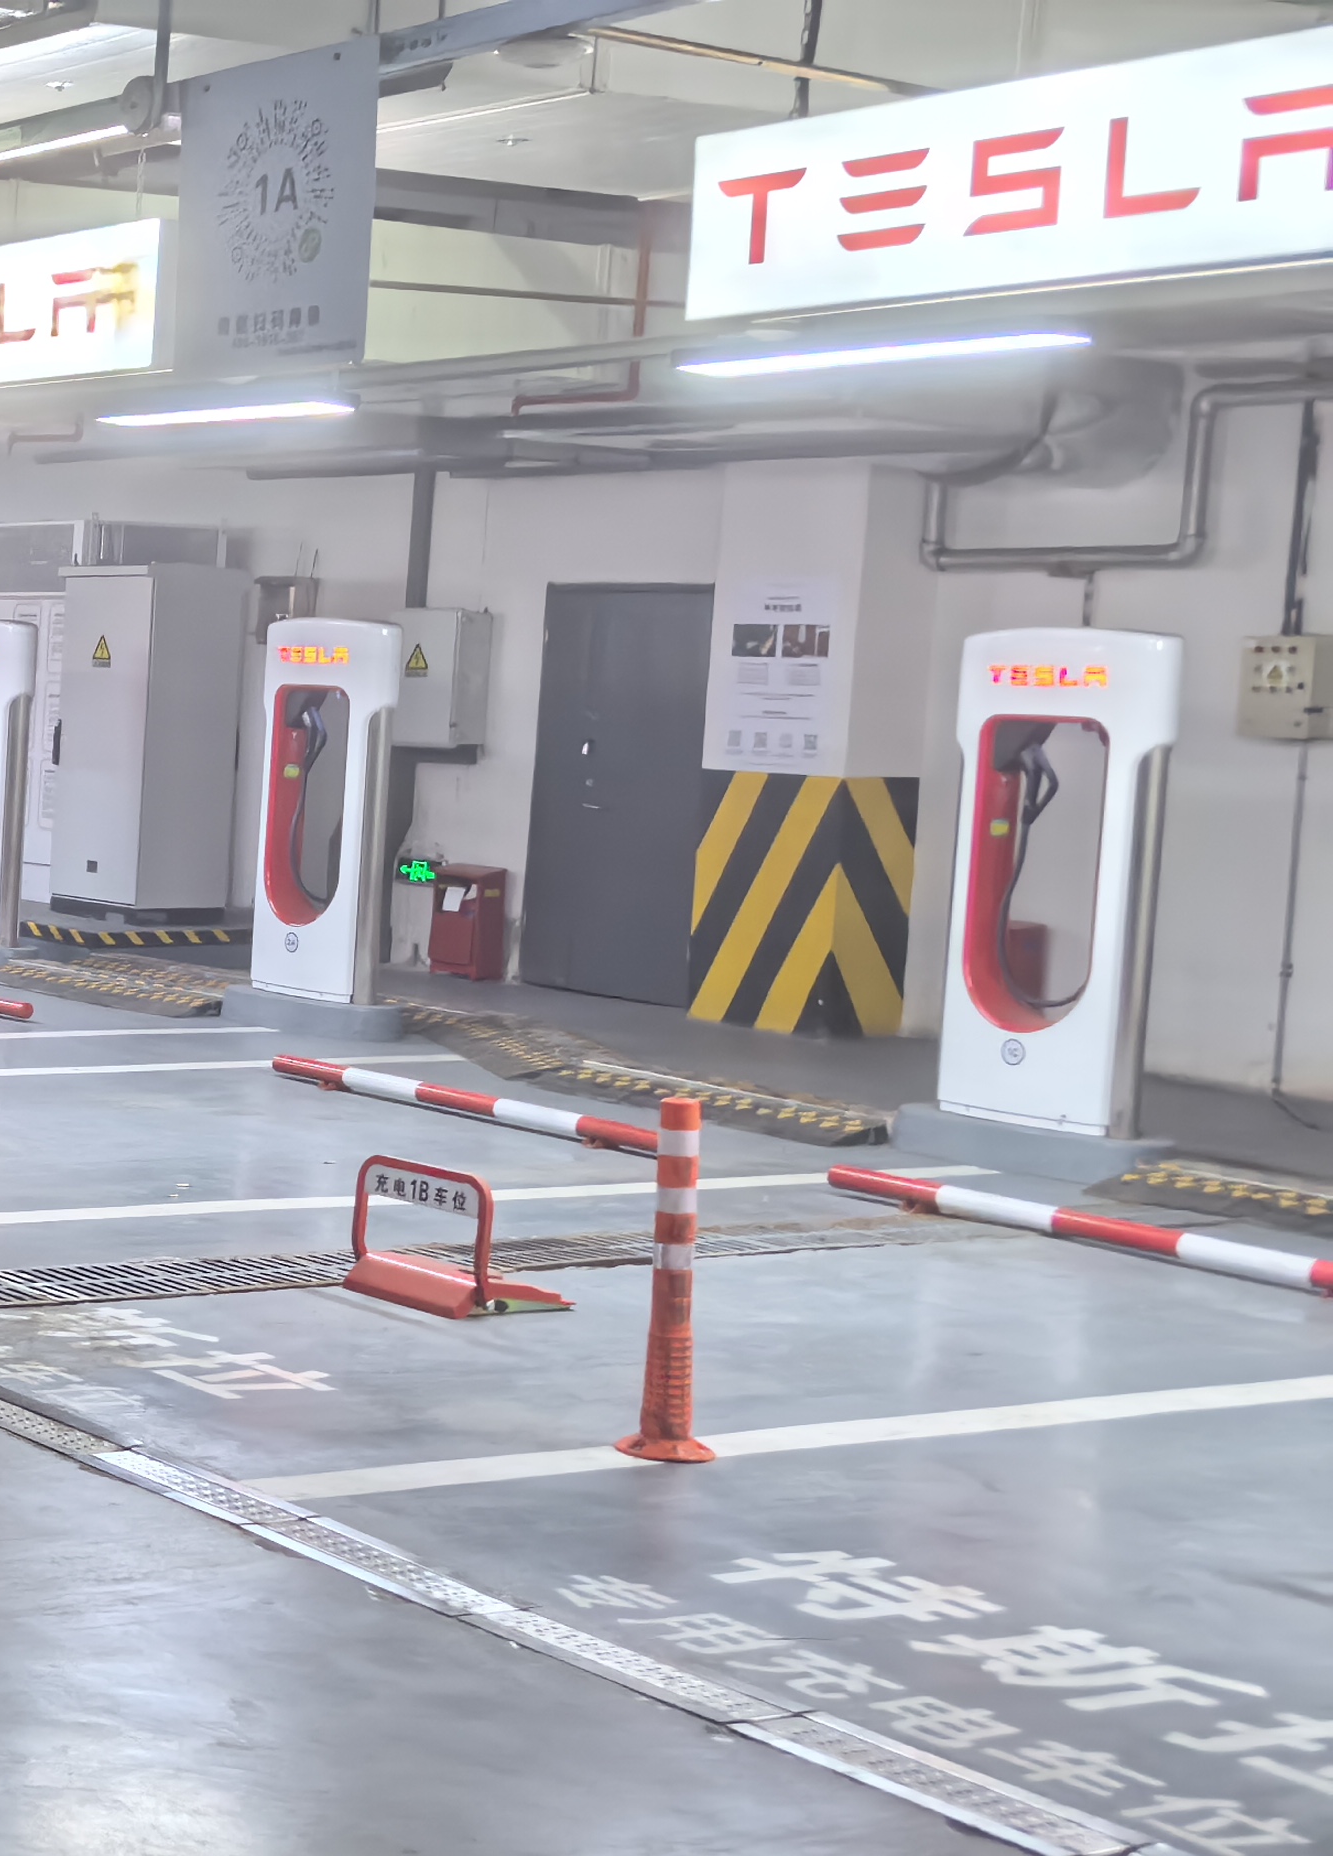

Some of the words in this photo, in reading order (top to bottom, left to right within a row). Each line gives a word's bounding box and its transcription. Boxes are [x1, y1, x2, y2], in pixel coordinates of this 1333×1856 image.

[255, 167, 298, 216] 1A
[718, 84, 1333, 265] TESLA
[277, 646, 350, 665] TESLA
[988, 665, 1108, 687] TESLA
[375, 1173, 466, 1211] 充电1B车位
[555, 1573, 1313, 1850] 专用充电车位
